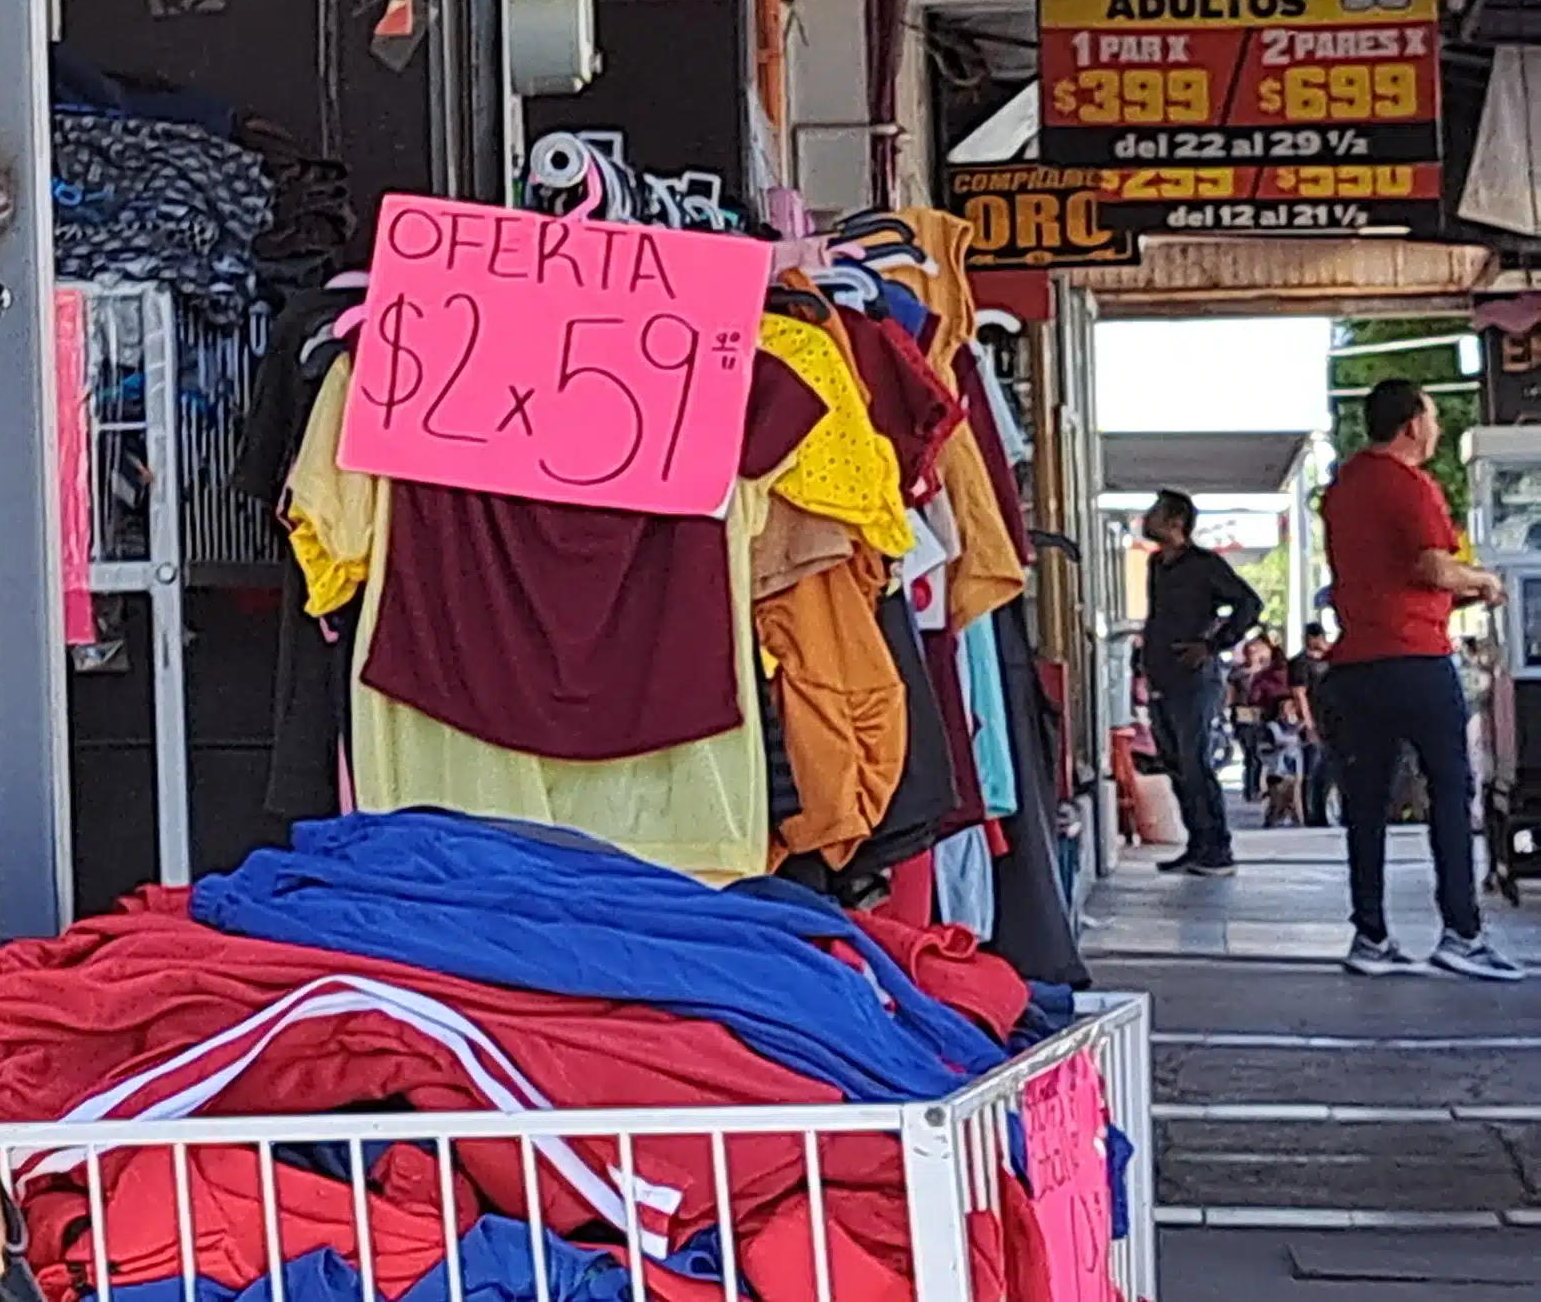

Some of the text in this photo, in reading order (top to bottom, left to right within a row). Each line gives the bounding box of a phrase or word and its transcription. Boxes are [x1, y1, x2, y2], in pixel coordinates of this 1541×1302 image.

[1099, 34, 1162, 63] PAR
[1261, 28, 1292, 67] 2
[1293, 30, 1401, 60] PARES
[1052, 68, 1209, 123] $399
[1257, 63, 1417, 122] $699
[1113, 132, 1169, 159] del
[1173, 132, 1228, 159] 22
[1230, 131, 1265, 157] al
[1268, 130, 1322, 156] 29
[1167, 204, 1214, 228] del
[1218, 204, 1256, 228] 12
[1258, 204, 1288, 227] al
[1292, 203, 1329, 226] 21
[387, 207, 677, 300] OFERTA
